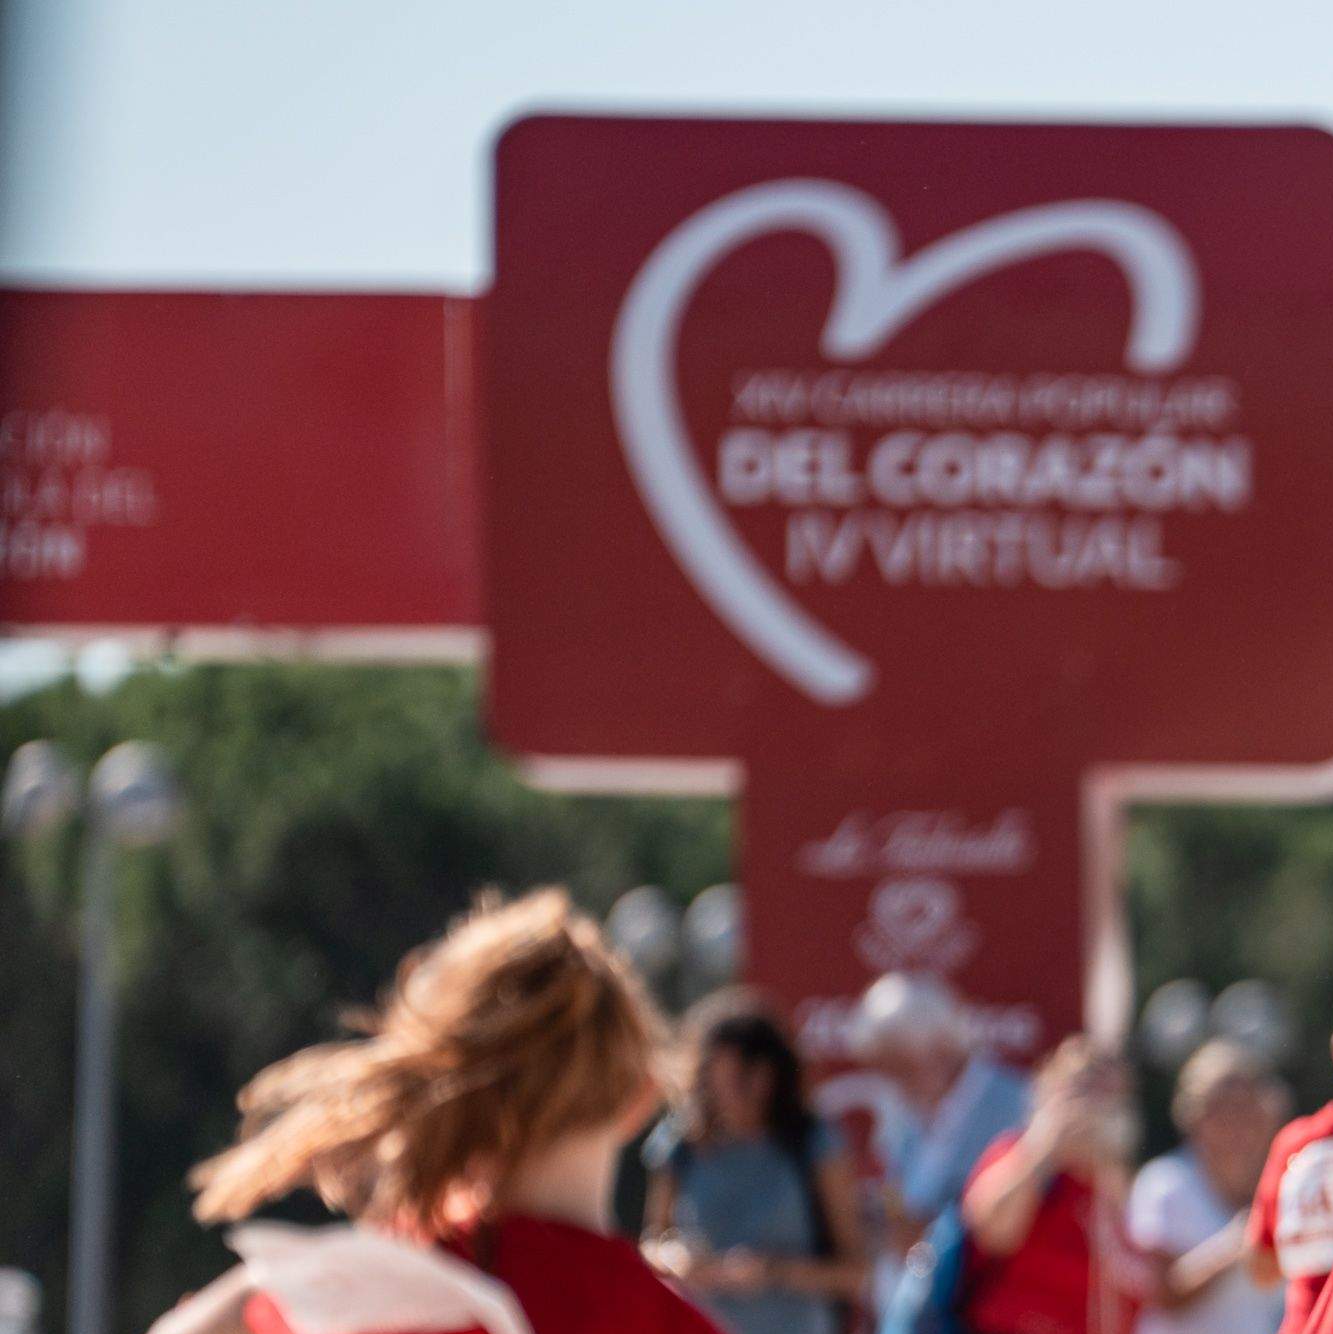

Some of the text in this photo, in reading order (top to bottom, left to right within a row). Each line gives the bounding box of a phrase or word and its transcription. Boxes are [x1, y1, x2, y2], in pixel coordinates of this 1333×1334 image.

[718, 420, 1252, 511] DEL CORAZÓN
[786, 510, 1182, 590] IV VIRTUAL
